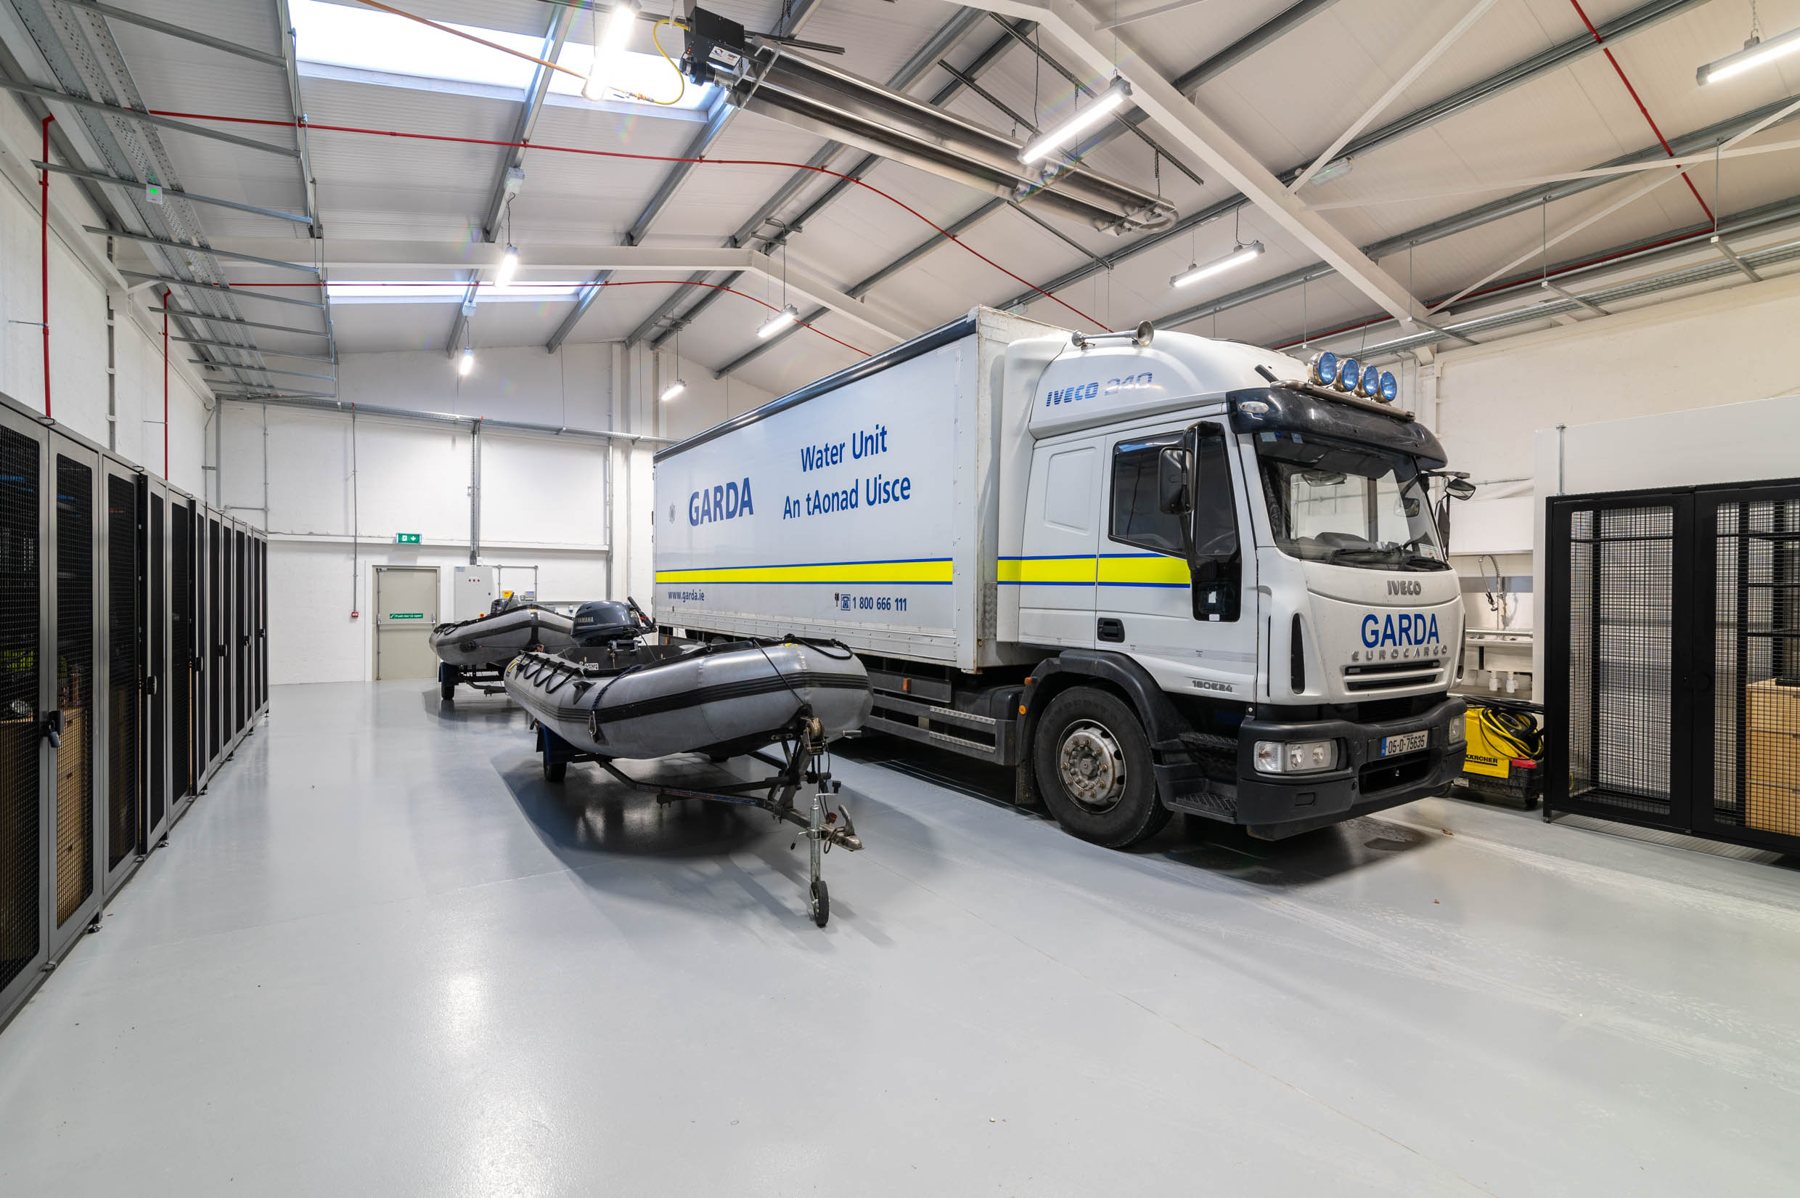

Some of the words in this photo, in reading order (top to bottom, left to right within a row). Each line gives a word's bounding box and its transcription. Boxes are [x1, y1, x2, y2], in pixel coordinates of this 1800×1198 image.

[1046, 382, 1099, 407] IVECO
[1104, 372, 1152, 396] 240
[801, 442, 846, 473] Water
[852, 424, 888, 460] Unit
[689, 477, 754, 526] GARDA
[783, 495, 801, 520] An
[806, 478, 859, 516] tAonad
[866, 474, 911, 506] Uisce
[668, 589, 705, 603] www.garda.ie
[853, 596, 857, 610] 1
[859, 597, 874, 610] 800
[876, 597, 892, 611] 666
[895, 597, 907, 612] 111
[1387, 580, 1422, 596] IVECO
[1361, 613, 1440, 649] GARDA
[1351, 645, 1448, 662] EUROCARGO
